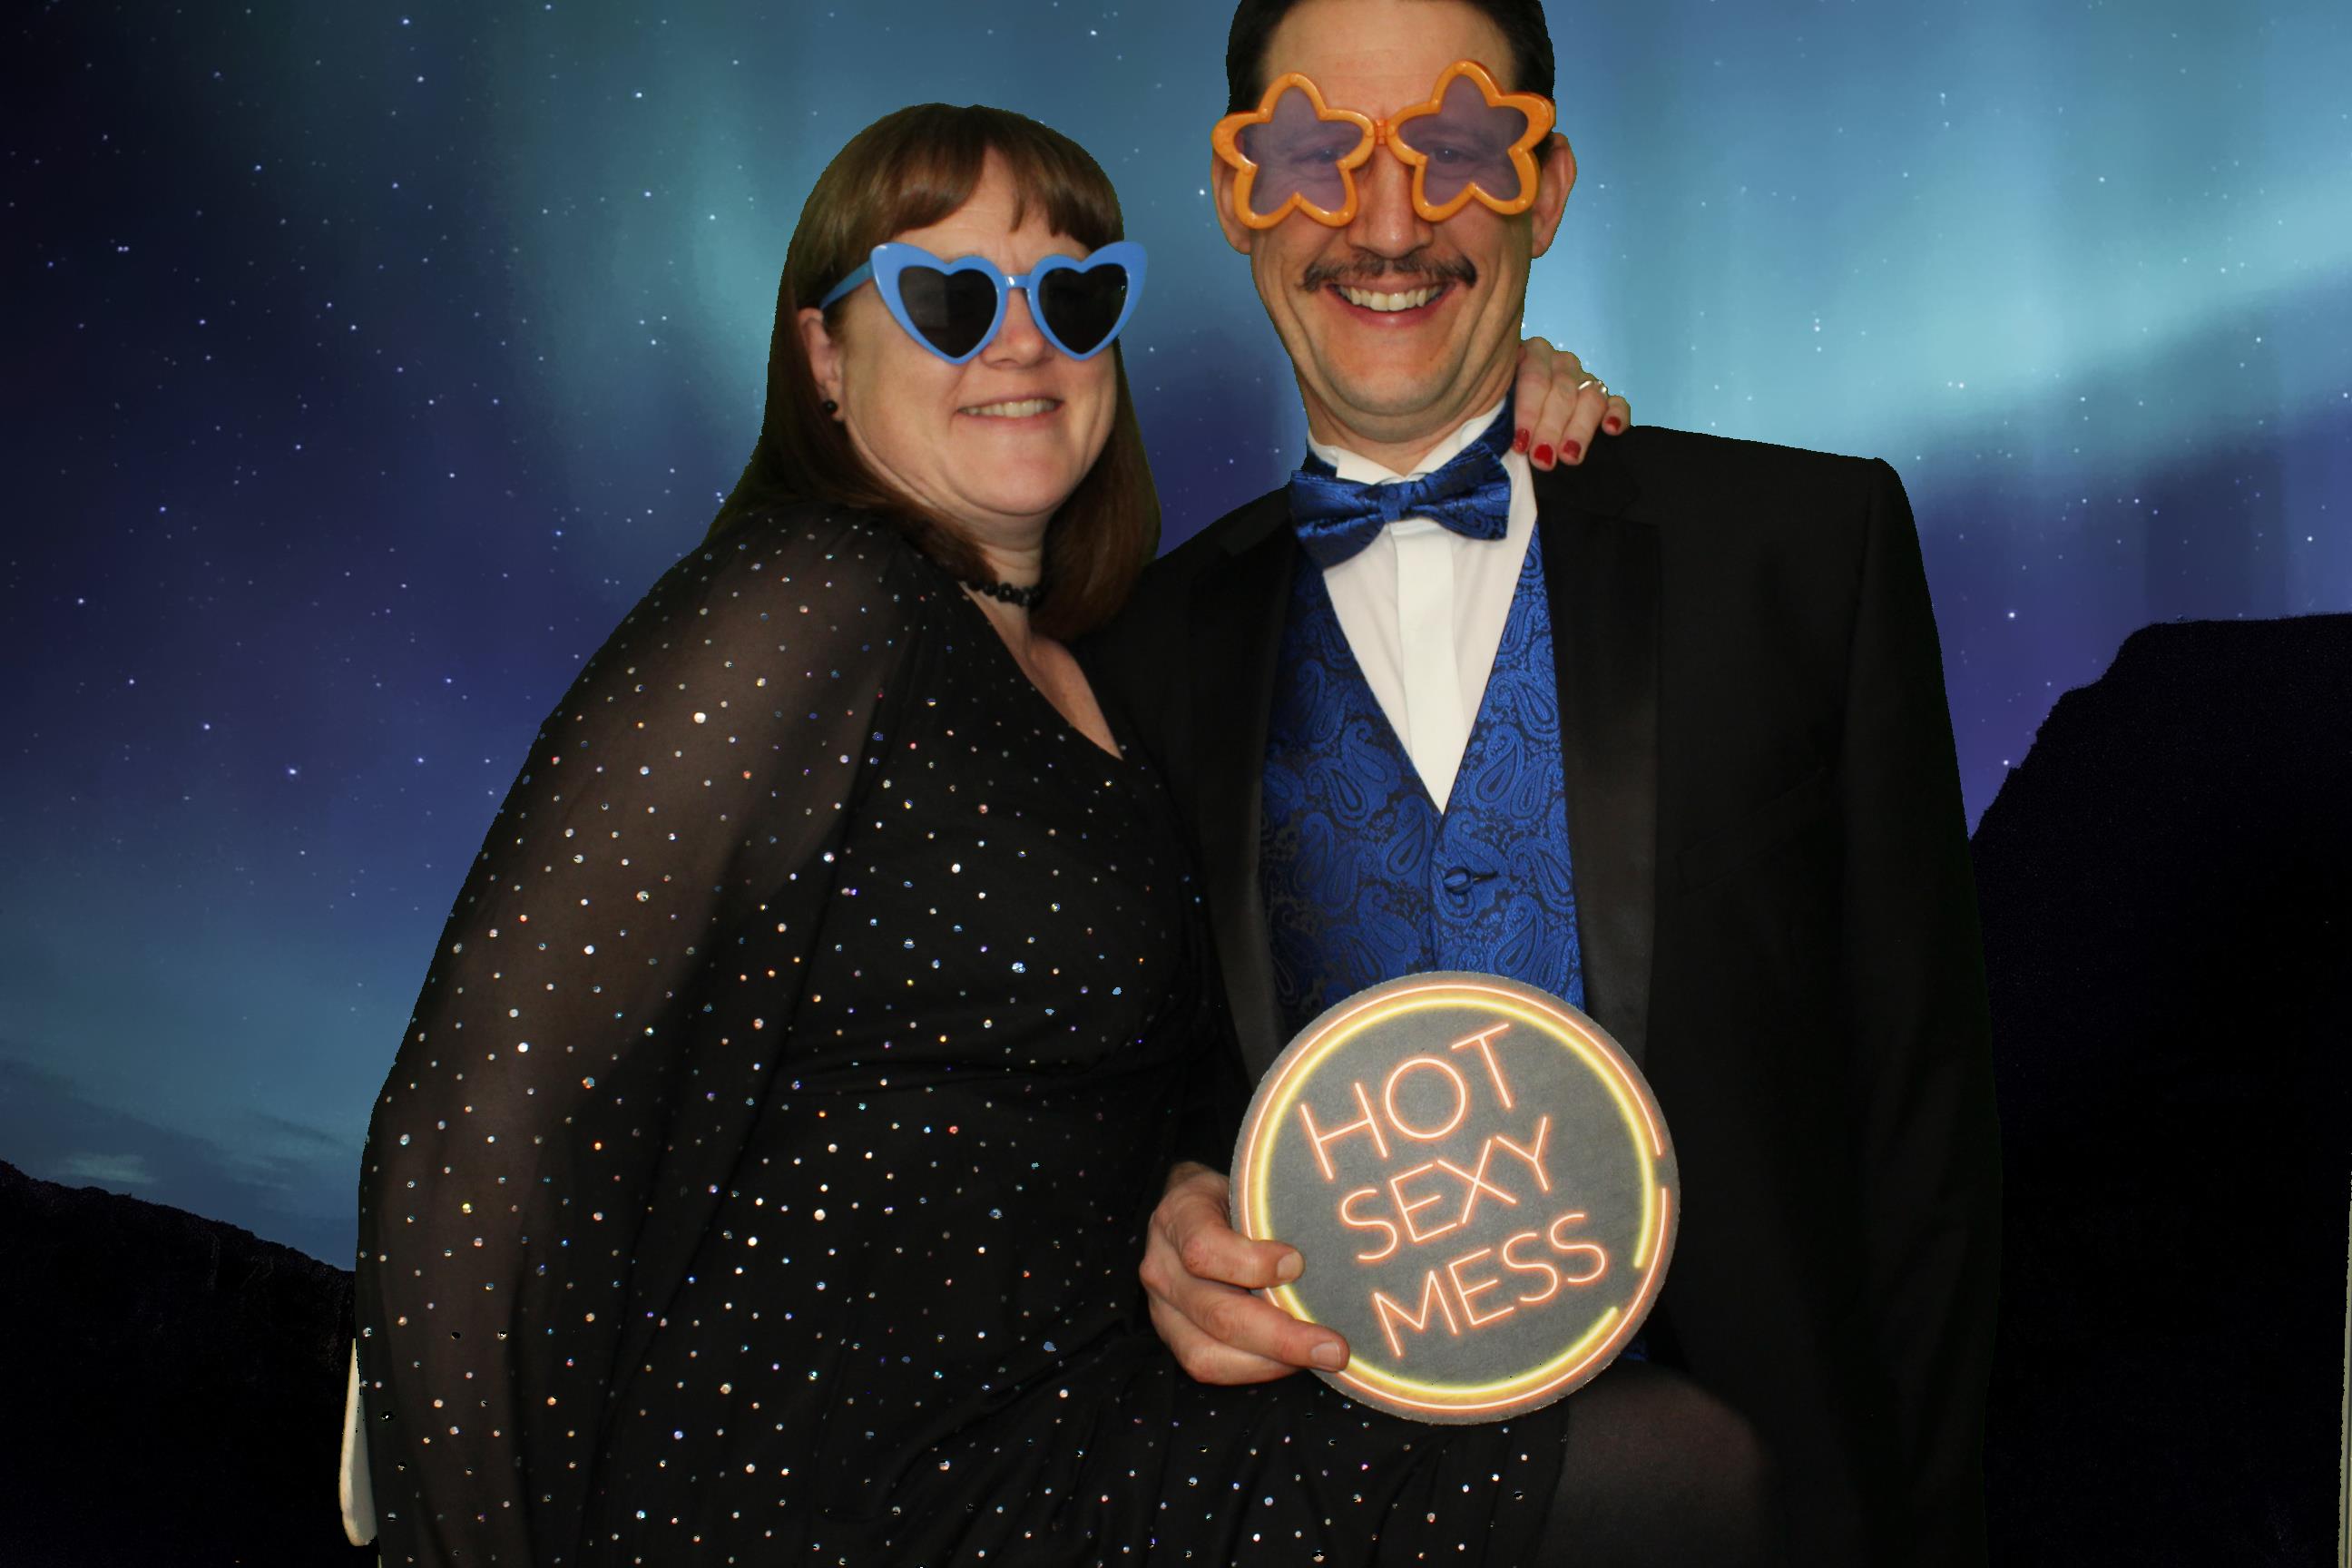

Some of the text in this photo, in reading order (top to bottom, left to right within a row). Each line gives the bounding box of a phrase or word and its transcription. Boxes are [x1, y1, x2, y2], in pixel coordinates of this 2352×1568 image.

[1299, 1022, 1513, 1181] HOT
[1338, 1114, 1553, 1263] SEXY
[1371, 1210, 1609, 1359] MESS
